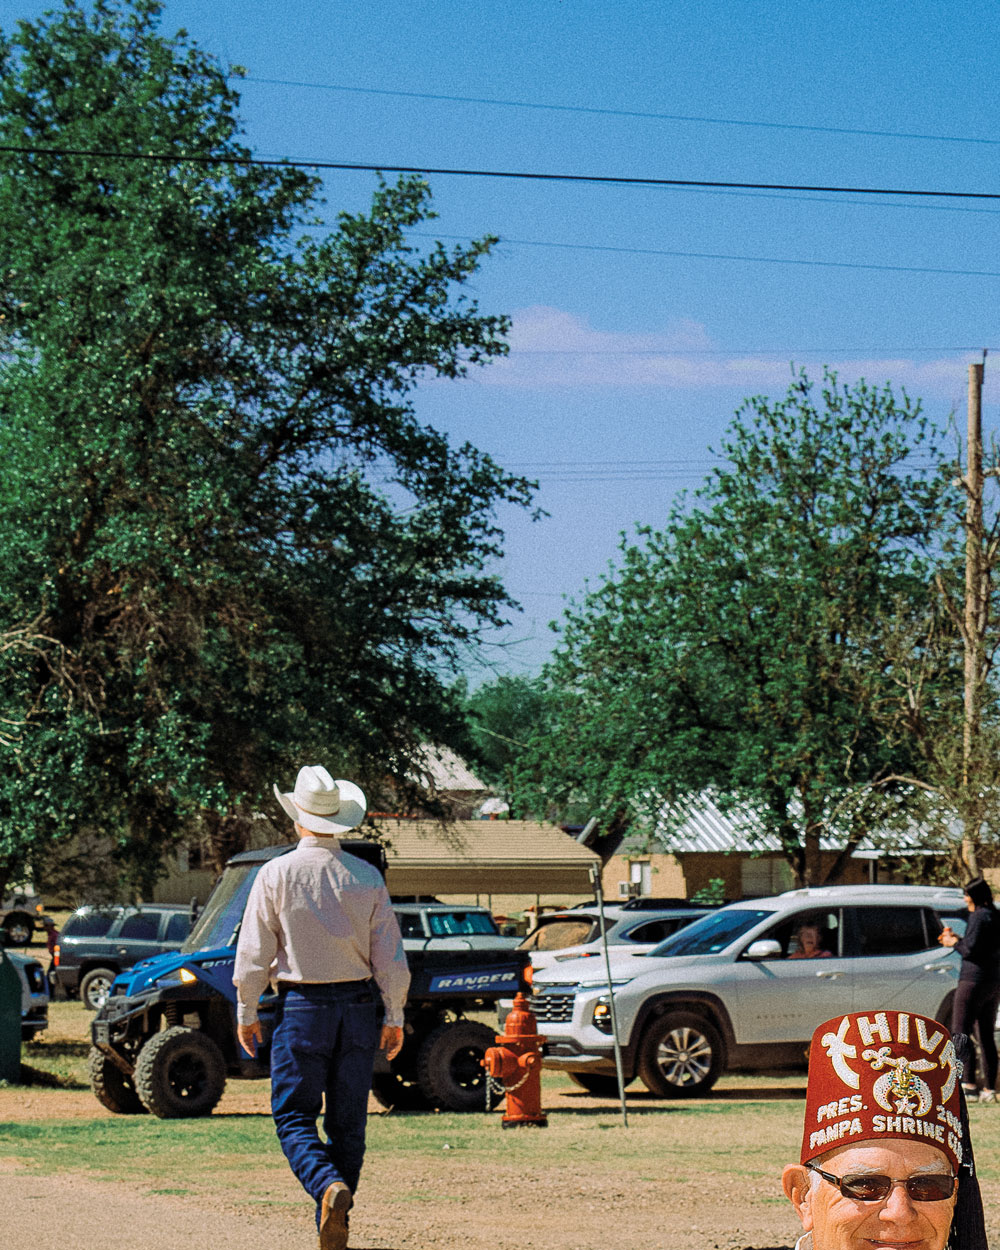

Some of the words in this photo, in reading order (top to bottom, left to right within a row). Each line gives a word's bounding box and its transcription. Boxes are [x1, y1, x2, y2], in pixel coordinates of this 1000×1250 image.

[437, 971, 517, 989] RANGER
[817, 1094, 868, 1124] PRES.
[809, 1117, 863, 1150] PAMPA
[872, 1114, 945, 1144] SHRINE
